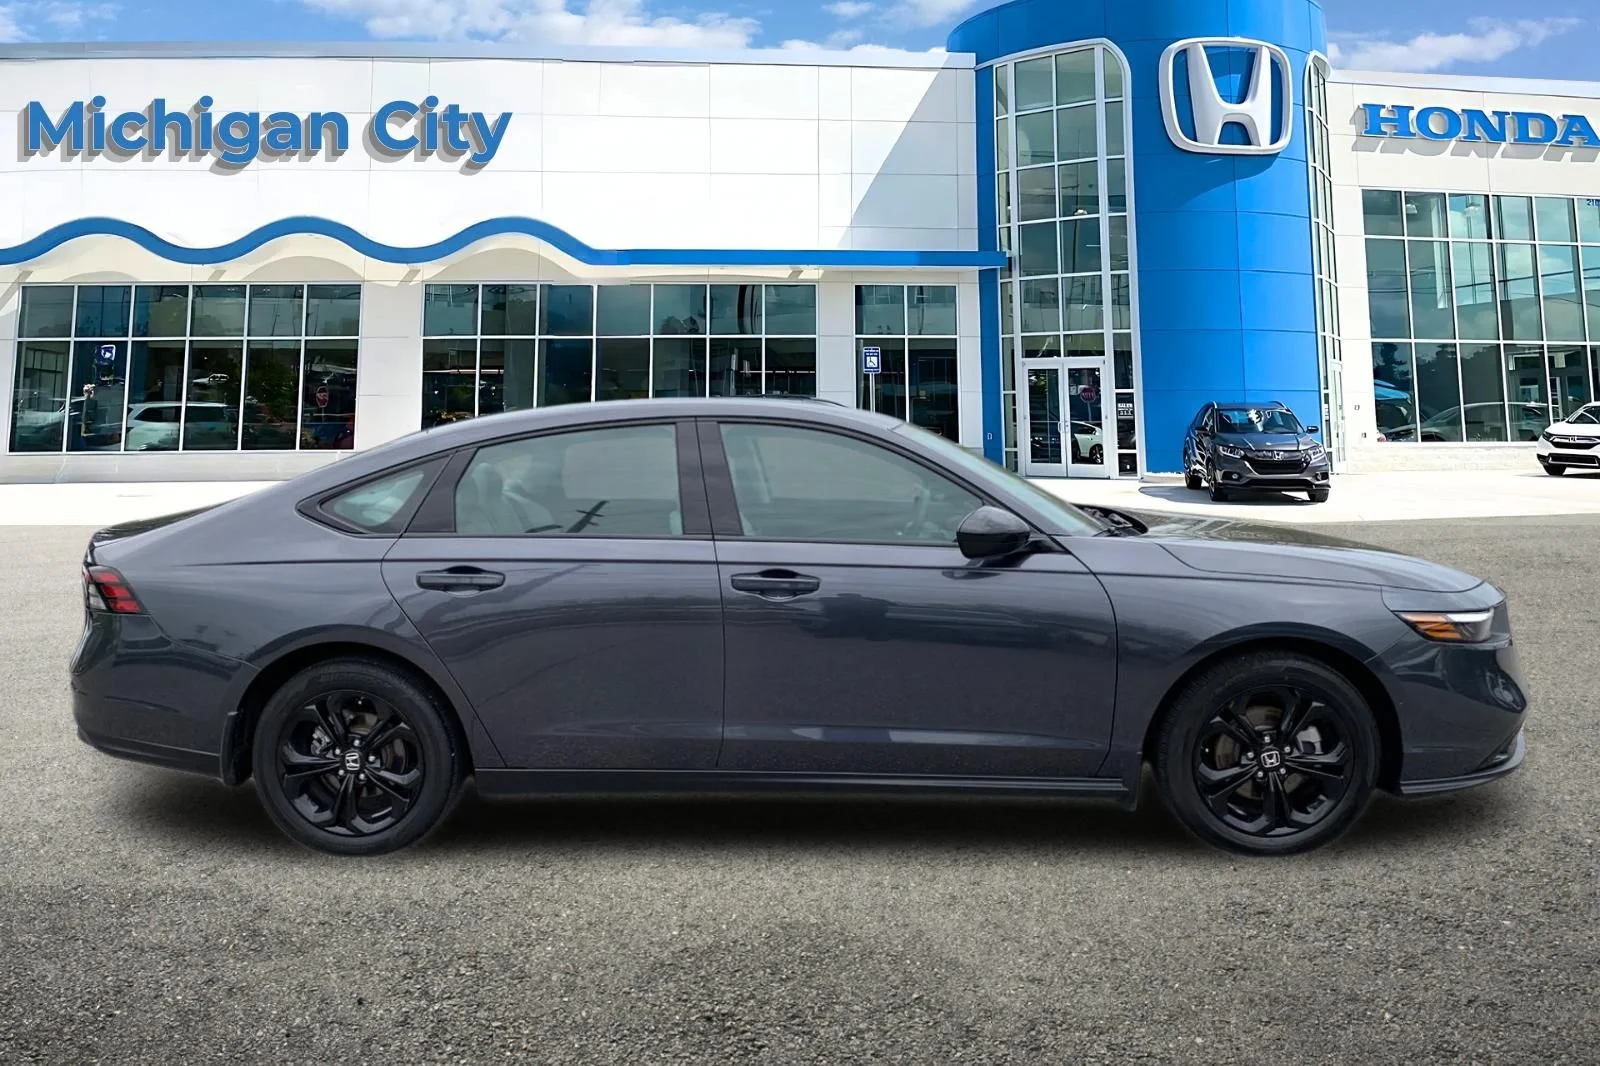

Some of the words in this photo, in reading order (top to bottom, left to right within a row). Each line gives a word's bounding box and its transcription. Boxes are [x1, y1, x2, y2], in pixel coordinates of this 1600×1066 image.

[28, 95, 350, 165] Michigan
[373, 95, 514, 165] City
[1361, 102, 1600, 149] HONDA
